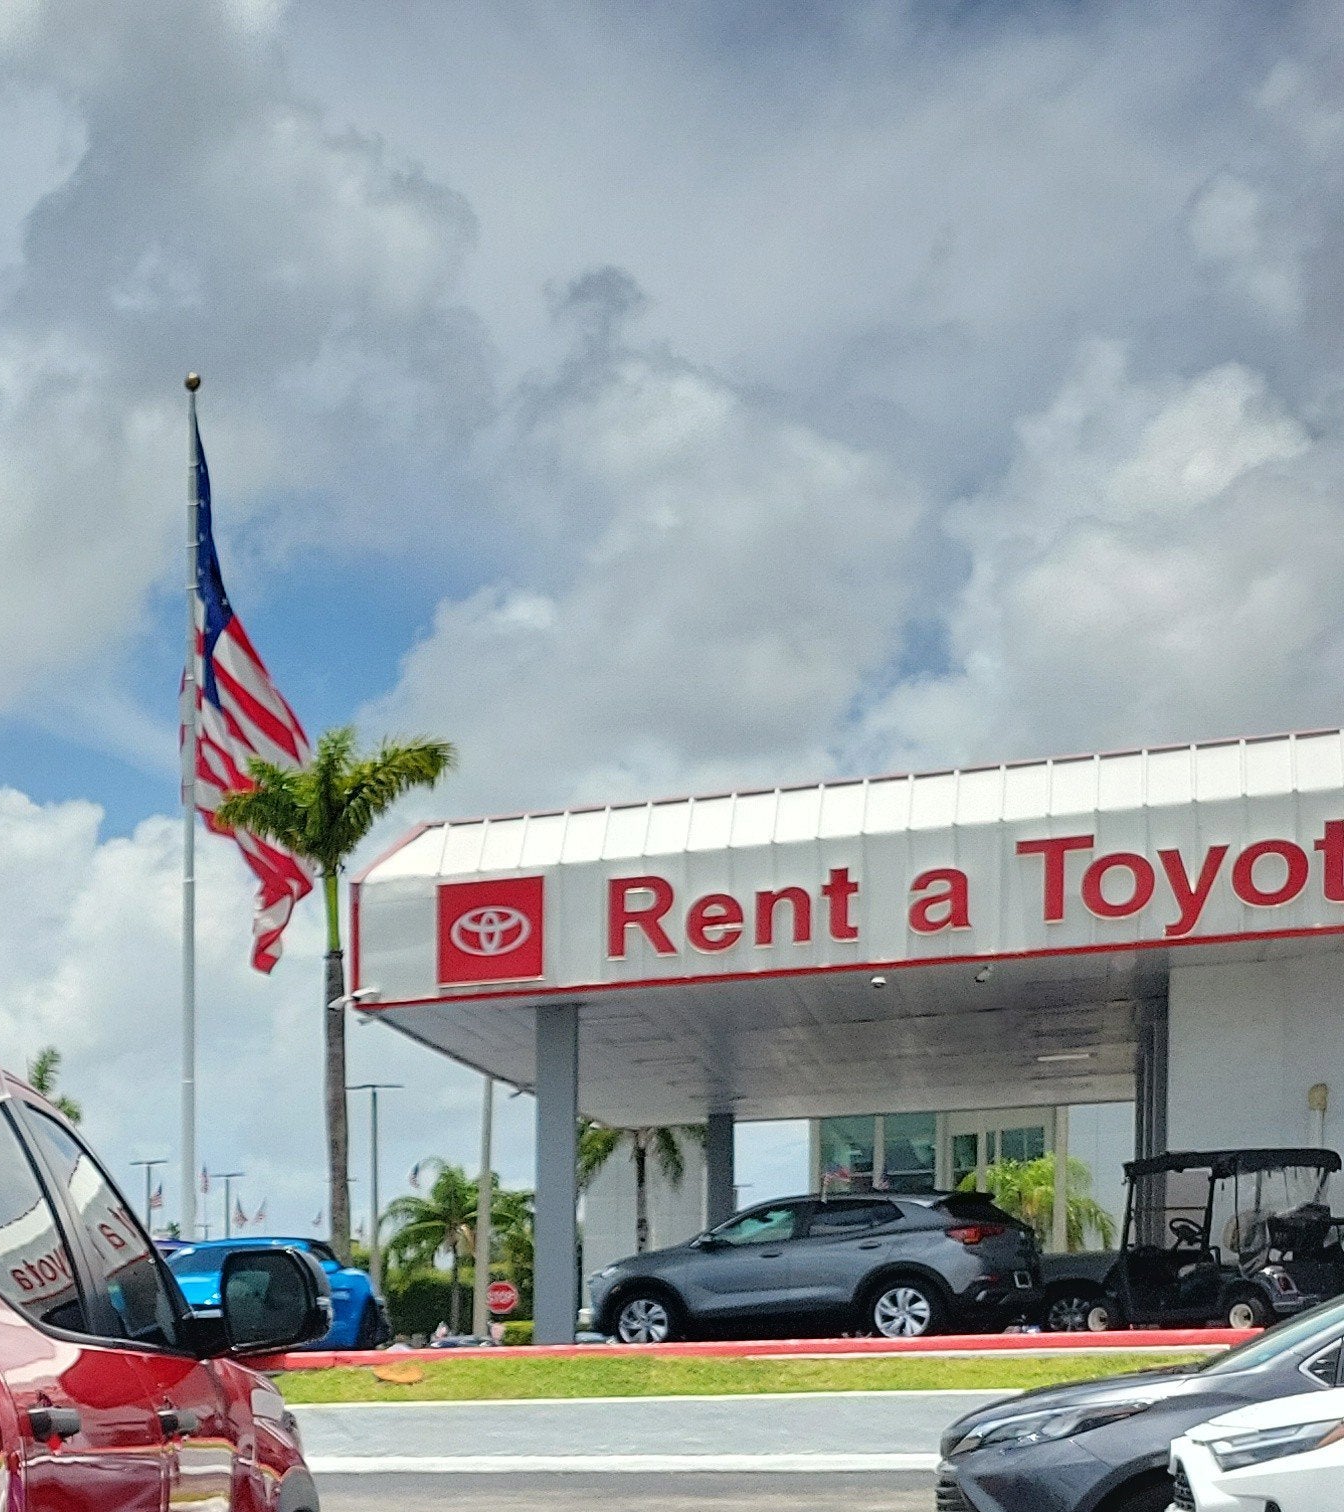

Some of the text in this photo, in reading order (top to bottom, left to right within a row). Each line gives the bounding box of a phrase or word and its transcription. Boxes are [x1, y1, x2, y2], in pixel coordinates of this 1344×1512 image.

[607, 867, 859, 959] Rent
[909, 866, 973, 934] a
[488, 1290, 516, 1304] STOP
